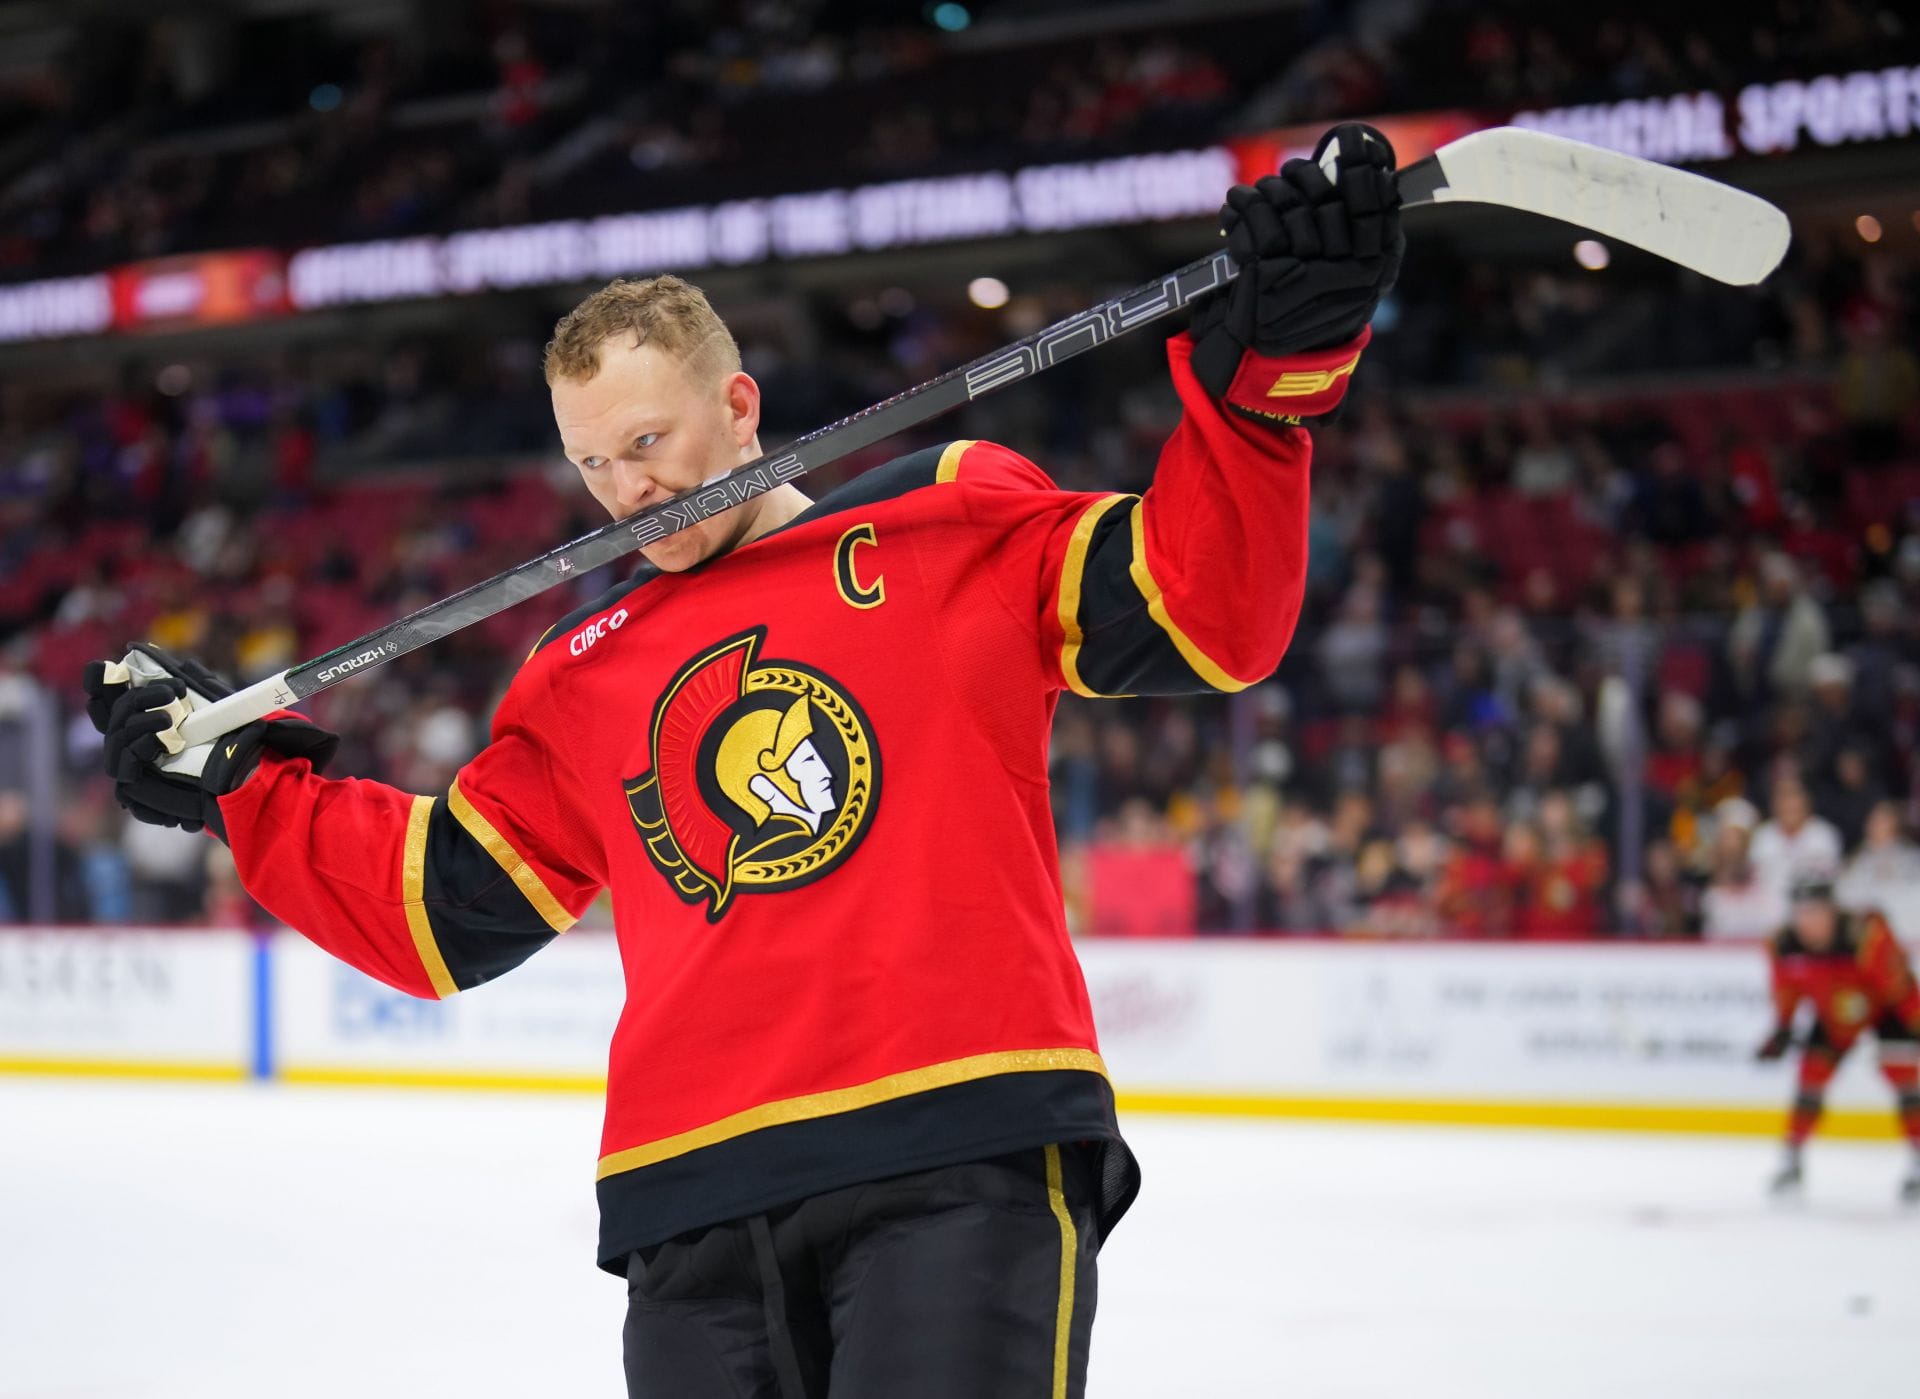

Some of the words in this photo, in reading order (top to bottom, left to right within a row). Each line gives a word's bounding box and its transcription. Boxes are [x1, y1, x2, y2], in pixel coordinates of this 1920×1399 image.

[1513, 88, 1733, 159] FICIAL
[966, 255, 1239, 401] TRUE
[631, 453, 807, 546] SMOKE
[833, 522, 886, 610] C
[316, 646, 385, 683] HZRDUS
[569, 616, 609, 657] CIBC
